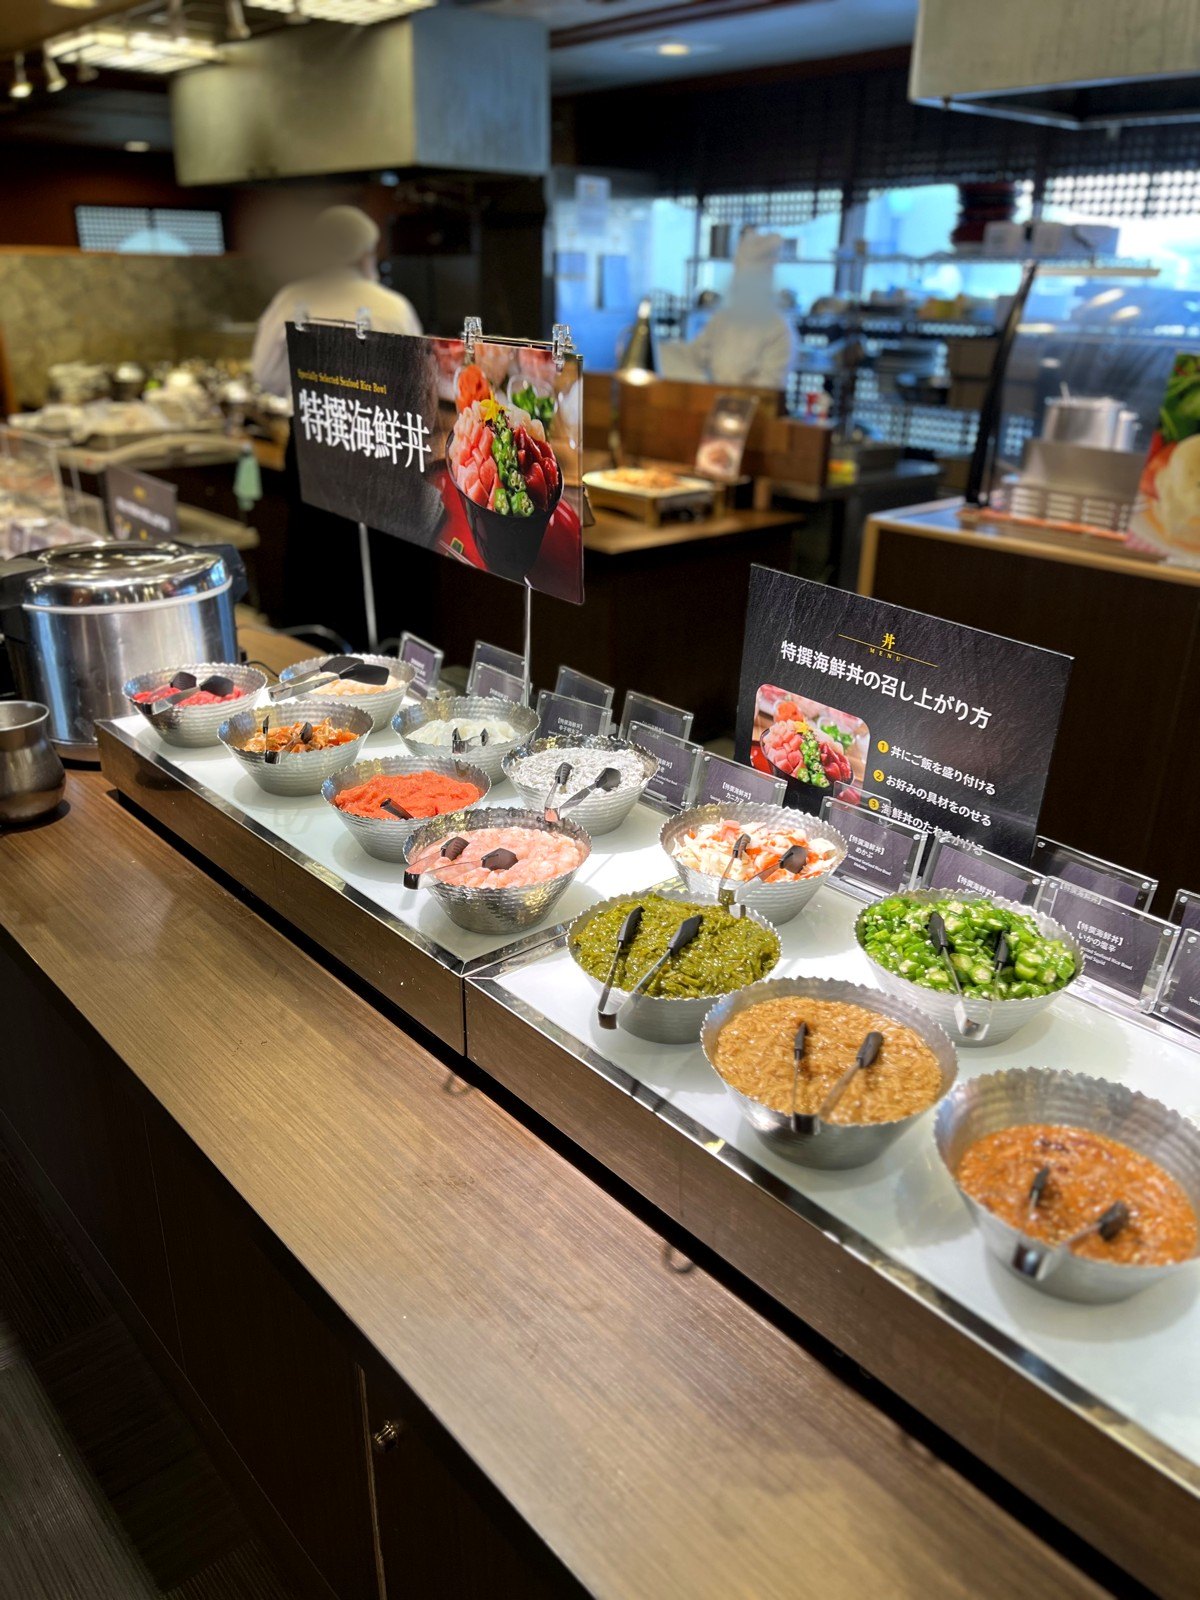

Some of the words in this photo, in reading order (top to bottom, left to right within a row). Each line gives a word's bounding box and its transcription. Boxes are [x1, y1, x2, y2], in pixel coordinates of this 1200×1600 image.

[318, 372, 339, 385] Selected
[339, 376, 359, 389] Seafood
[360, 380, 372, 391] Rice
[372, 382, 387, 395] Bowl
[299, 388, 432, 473] 特撰海鮮丼
[869, 647, 901, 662] MENU
[881, 632, 896, 650] 丼
[780, 640, 993, 729] 特撰海鮮丼の召し上がり方
[890, 745, 996, 796] 丼にご飯を盛り付ける
[885, 775, 992, 827] お好みの具材をのせる
[855, 846, 874, 859] めかぶ
